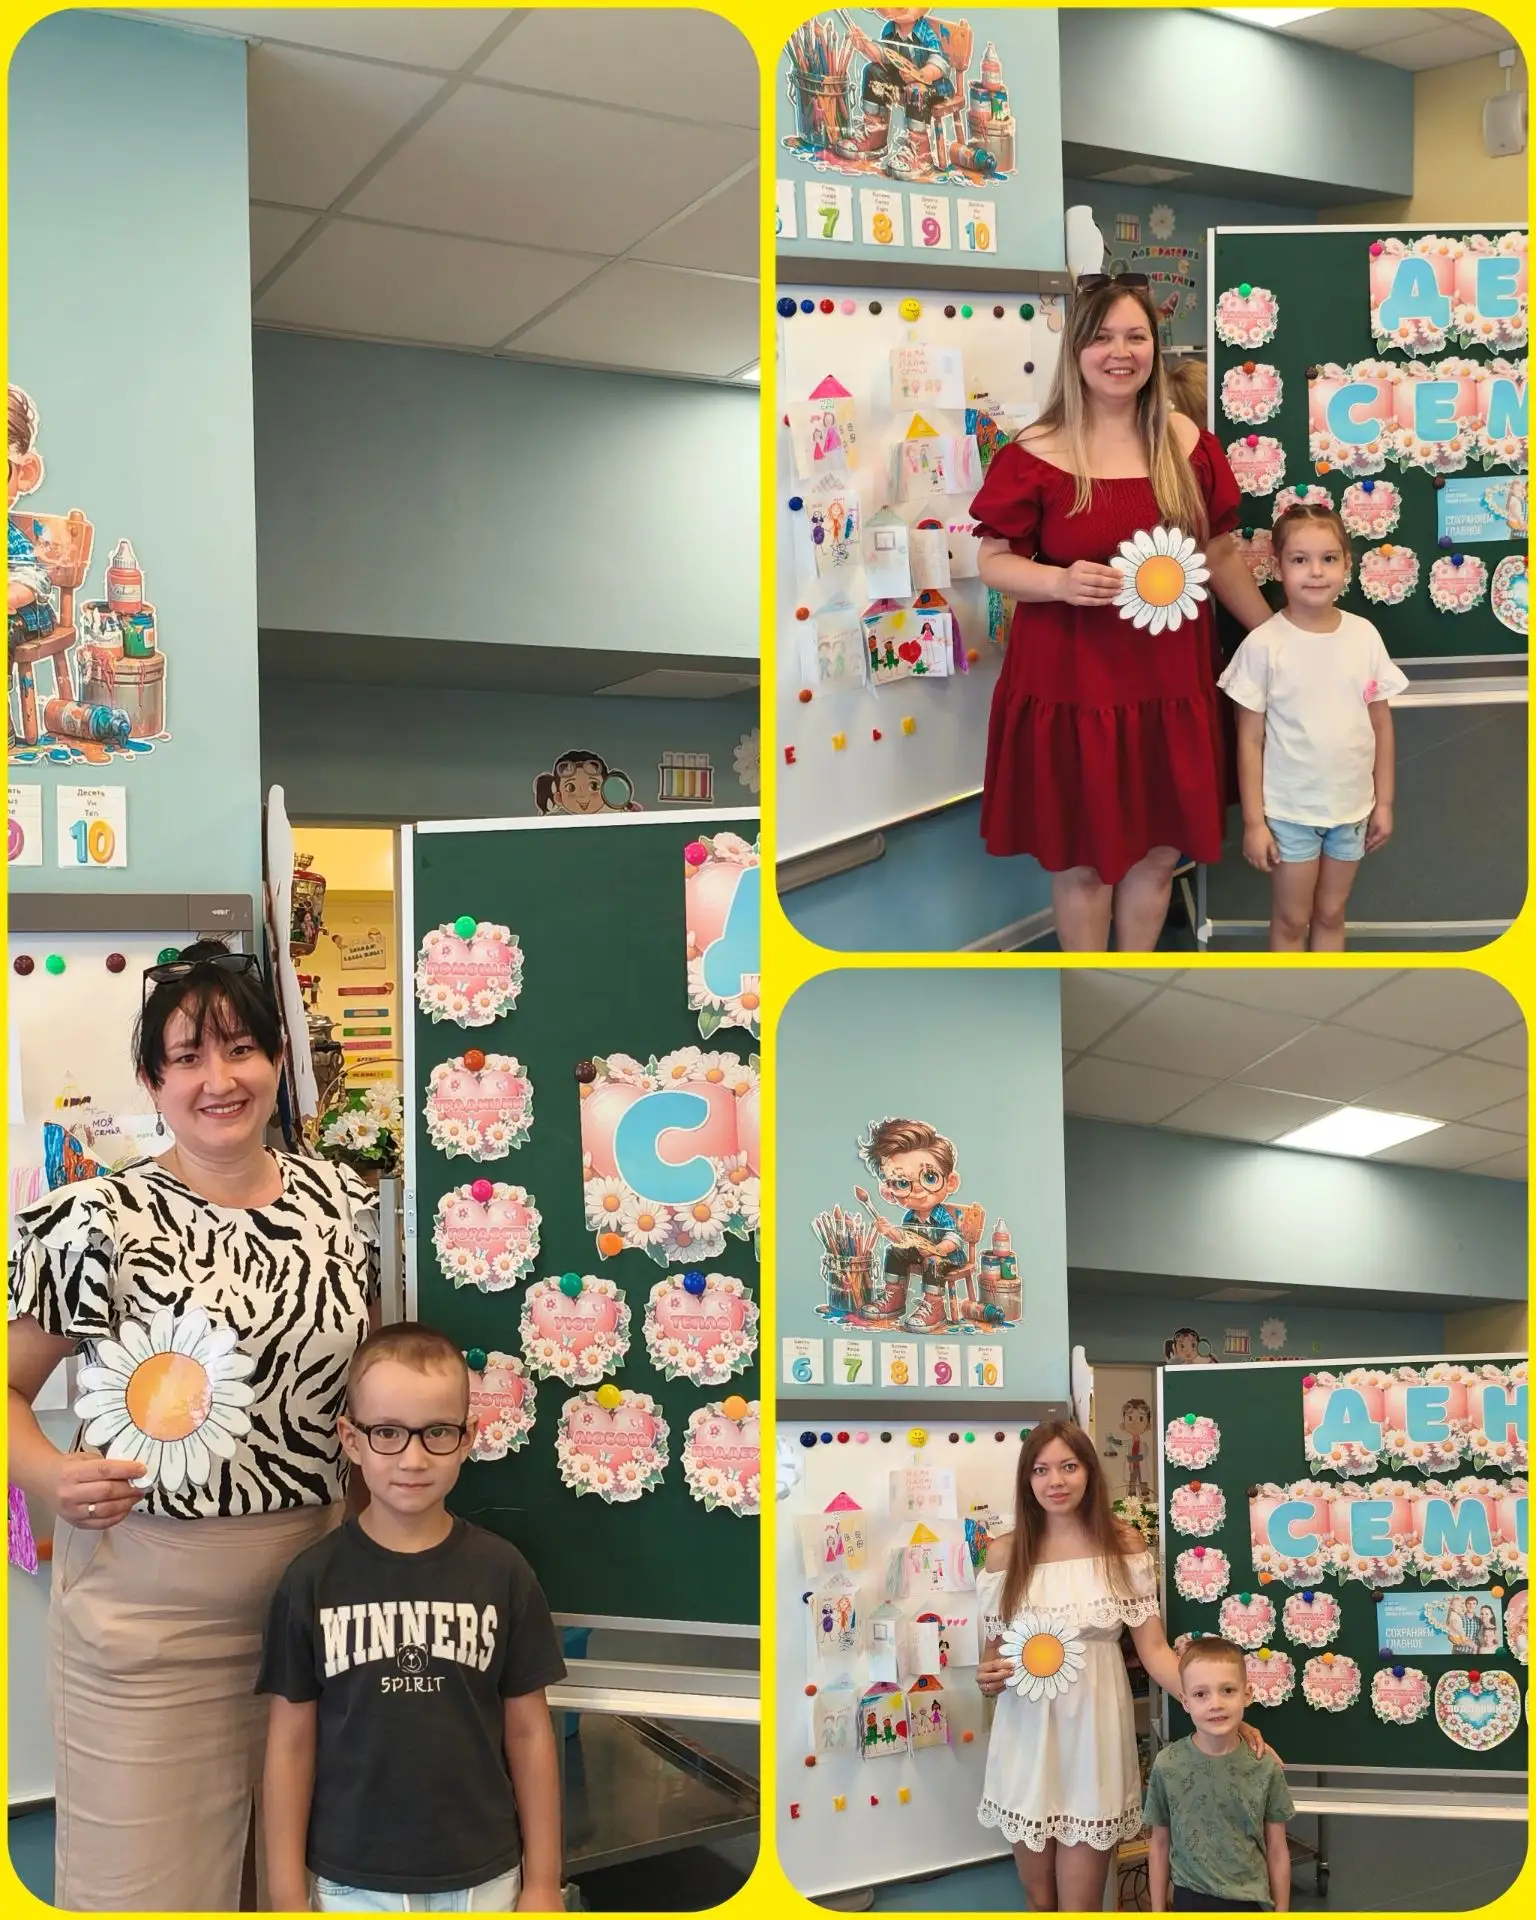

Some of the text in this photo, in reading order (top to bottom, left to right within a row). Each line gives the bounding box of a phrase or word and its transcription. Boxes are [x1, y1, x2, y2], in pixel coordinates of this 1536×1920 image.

[817, 207, 840, 238] 7
[872, 212, 894, 245] 8
[921, 217, 941, 247] 9
[964, 221, 990, 250] 10
[1445, 513, 1494, 526] СОХРАНЯЕМ
[1445, 525, 1482, 537] ГЛАВНОЕ
[77, 788, 105, 797] Десять
[69, 820, 115, 864] 10
[426, 961, 511, 977] ПОМОЩЬ
[92, 1117, 113, 1127] МОЯ
[613, 1089, 717, 1206] С
[447, 1226, 530, 1242] ГОРДОСТЬ
[553, 1316, 596, 1331] УЮТ
[669, 1315, 731, 1331] ТЕПЛО
[792, 1357, 813, 1383] 6
[843, 1357, 863, 1382] 7
[890, 1360, 909, 1385] 8
[934, 1361, 952, 1385] 9
[974, 1363, 998, 1386] 10
[470, 1391, 514, 1408] БОТА
[573, 1431, 651, 1447] ЛЮБОВЬ
[691, 1446, 760, 1460] ПОДДЕР
[1267, 1498, 1528, 1558] СЕМ
[319, 1600, 498, 1679] WINNERS
[1385, 1627, 1434, 1638] СОХРАНЯЕМ
[1386, 1638, 1424, 1649] ГЛАВНОЕ
